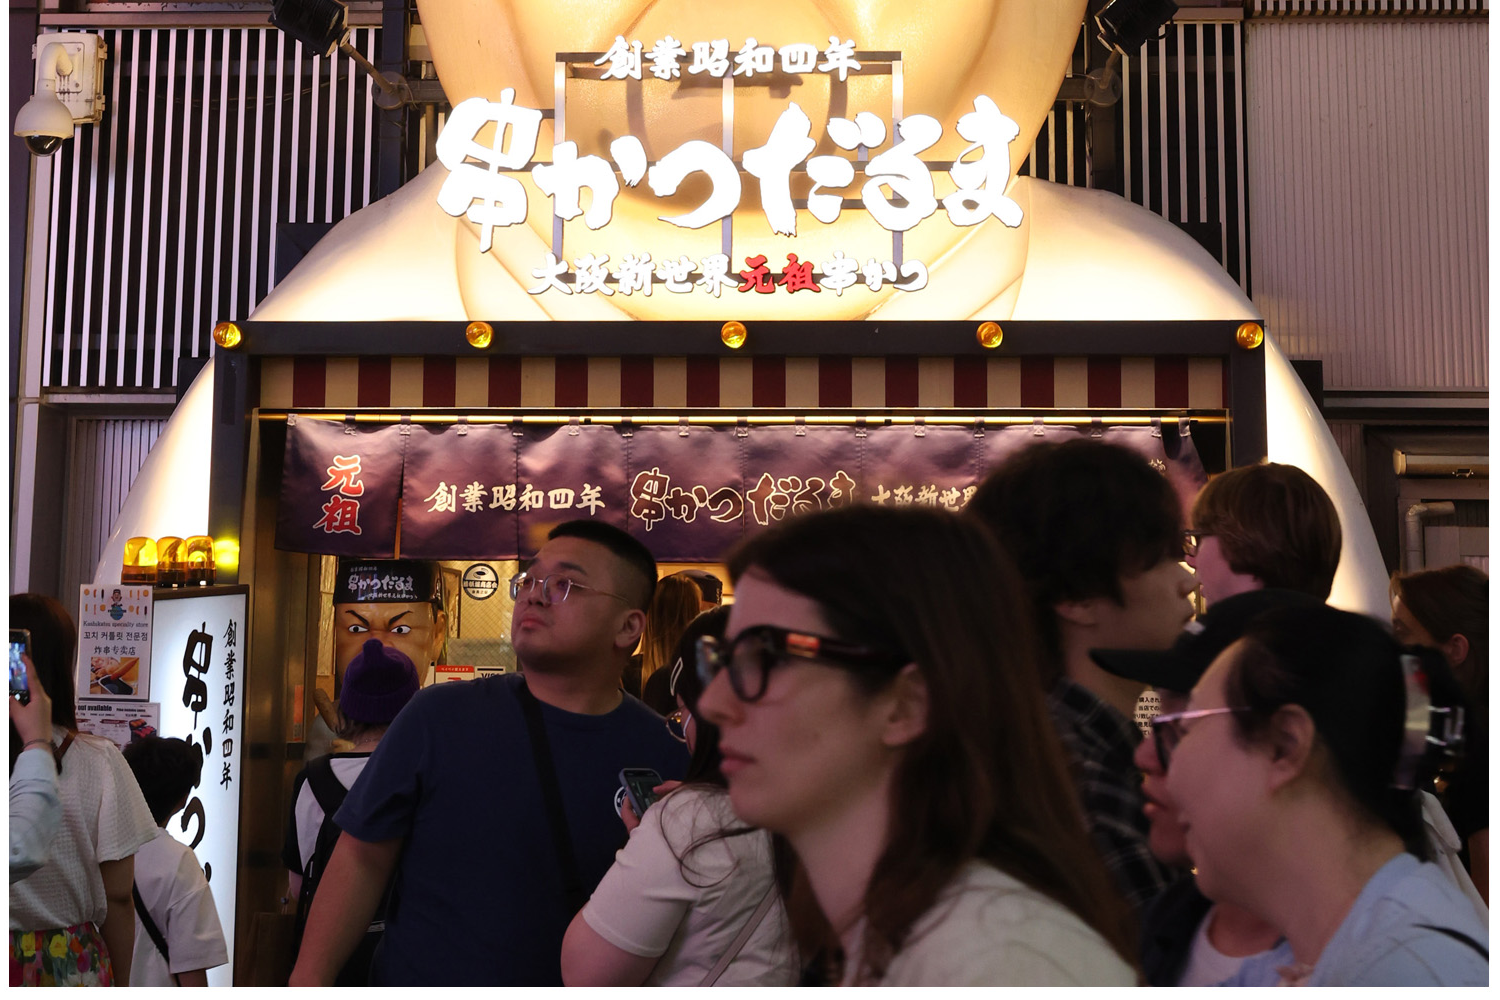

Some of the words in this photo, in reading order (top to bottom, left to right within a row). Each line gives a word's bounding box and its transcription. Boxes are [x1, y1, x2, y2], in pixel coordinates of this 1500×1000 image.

[595, 34, 861, 81] 創業昭和四年
[435, 87, 1025, 253] 串かつだるま
[526, 251, 930, 296] 大阪新世界元祖串かつ
[313, 454, 364, 536] 元祖
[423, 481, 606, 516] 創業昭和四年
[630, 467, 856, 531] 串かつだるま
[220, 619, 237, 790] 創業昭和四年
